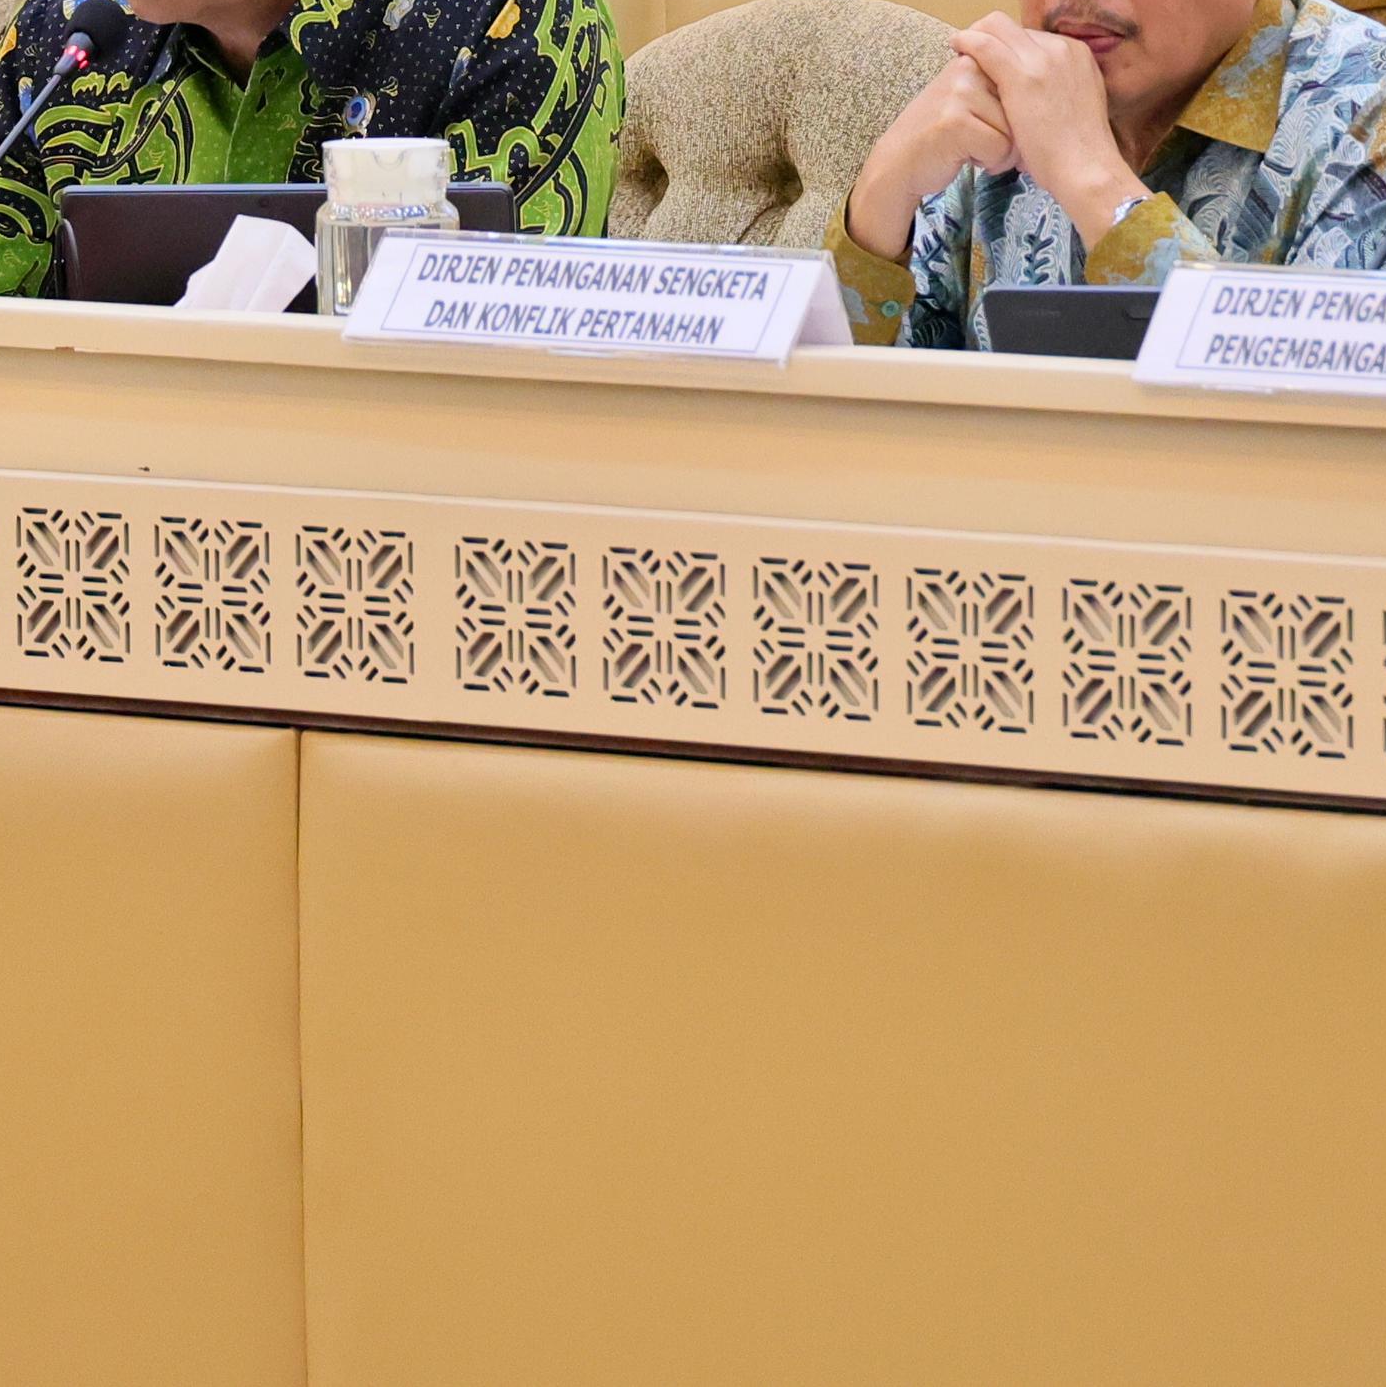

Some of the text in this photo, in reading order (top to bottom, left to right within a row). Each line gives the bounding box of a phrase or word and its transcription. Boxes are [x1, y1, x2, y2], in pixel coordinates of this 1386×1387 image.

[418, 253, 769, 302] DIRJEN PENANGANAN SENGKETA
[424, 300, 725, 346] DAN KONFLIK PERTANAHAN
[1212, 286, 1307, 319] DIRJEN
